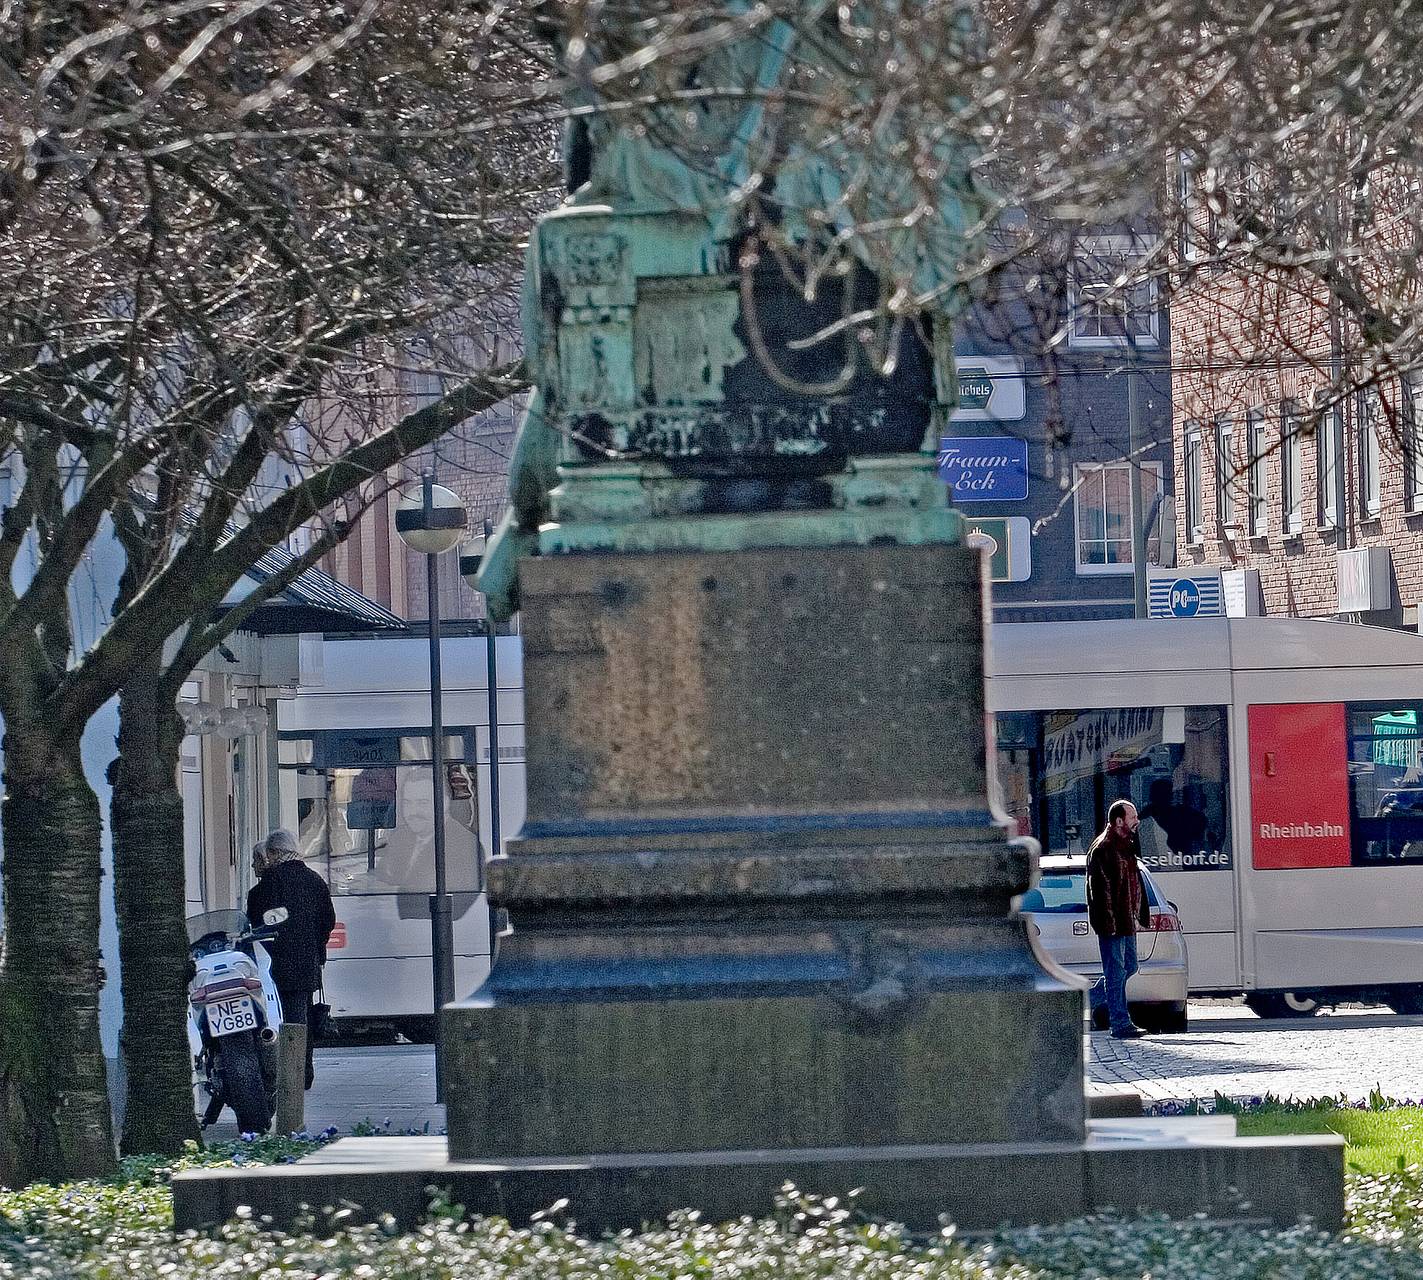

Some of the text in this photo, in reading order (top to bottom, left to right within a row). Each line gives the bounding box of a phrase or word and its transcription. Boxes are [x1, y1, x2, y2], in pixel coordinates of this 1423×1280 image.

[959, 384, 990, 396] iebels
[938, 449, 1020, 469] Traum-
[955, 471, 996, 490] Eck
[1260, 821, 1344, 839] Rheinbahn
[217, 1000, 242, 1017] NE
[211, 1013, 254, 1033] YG88
